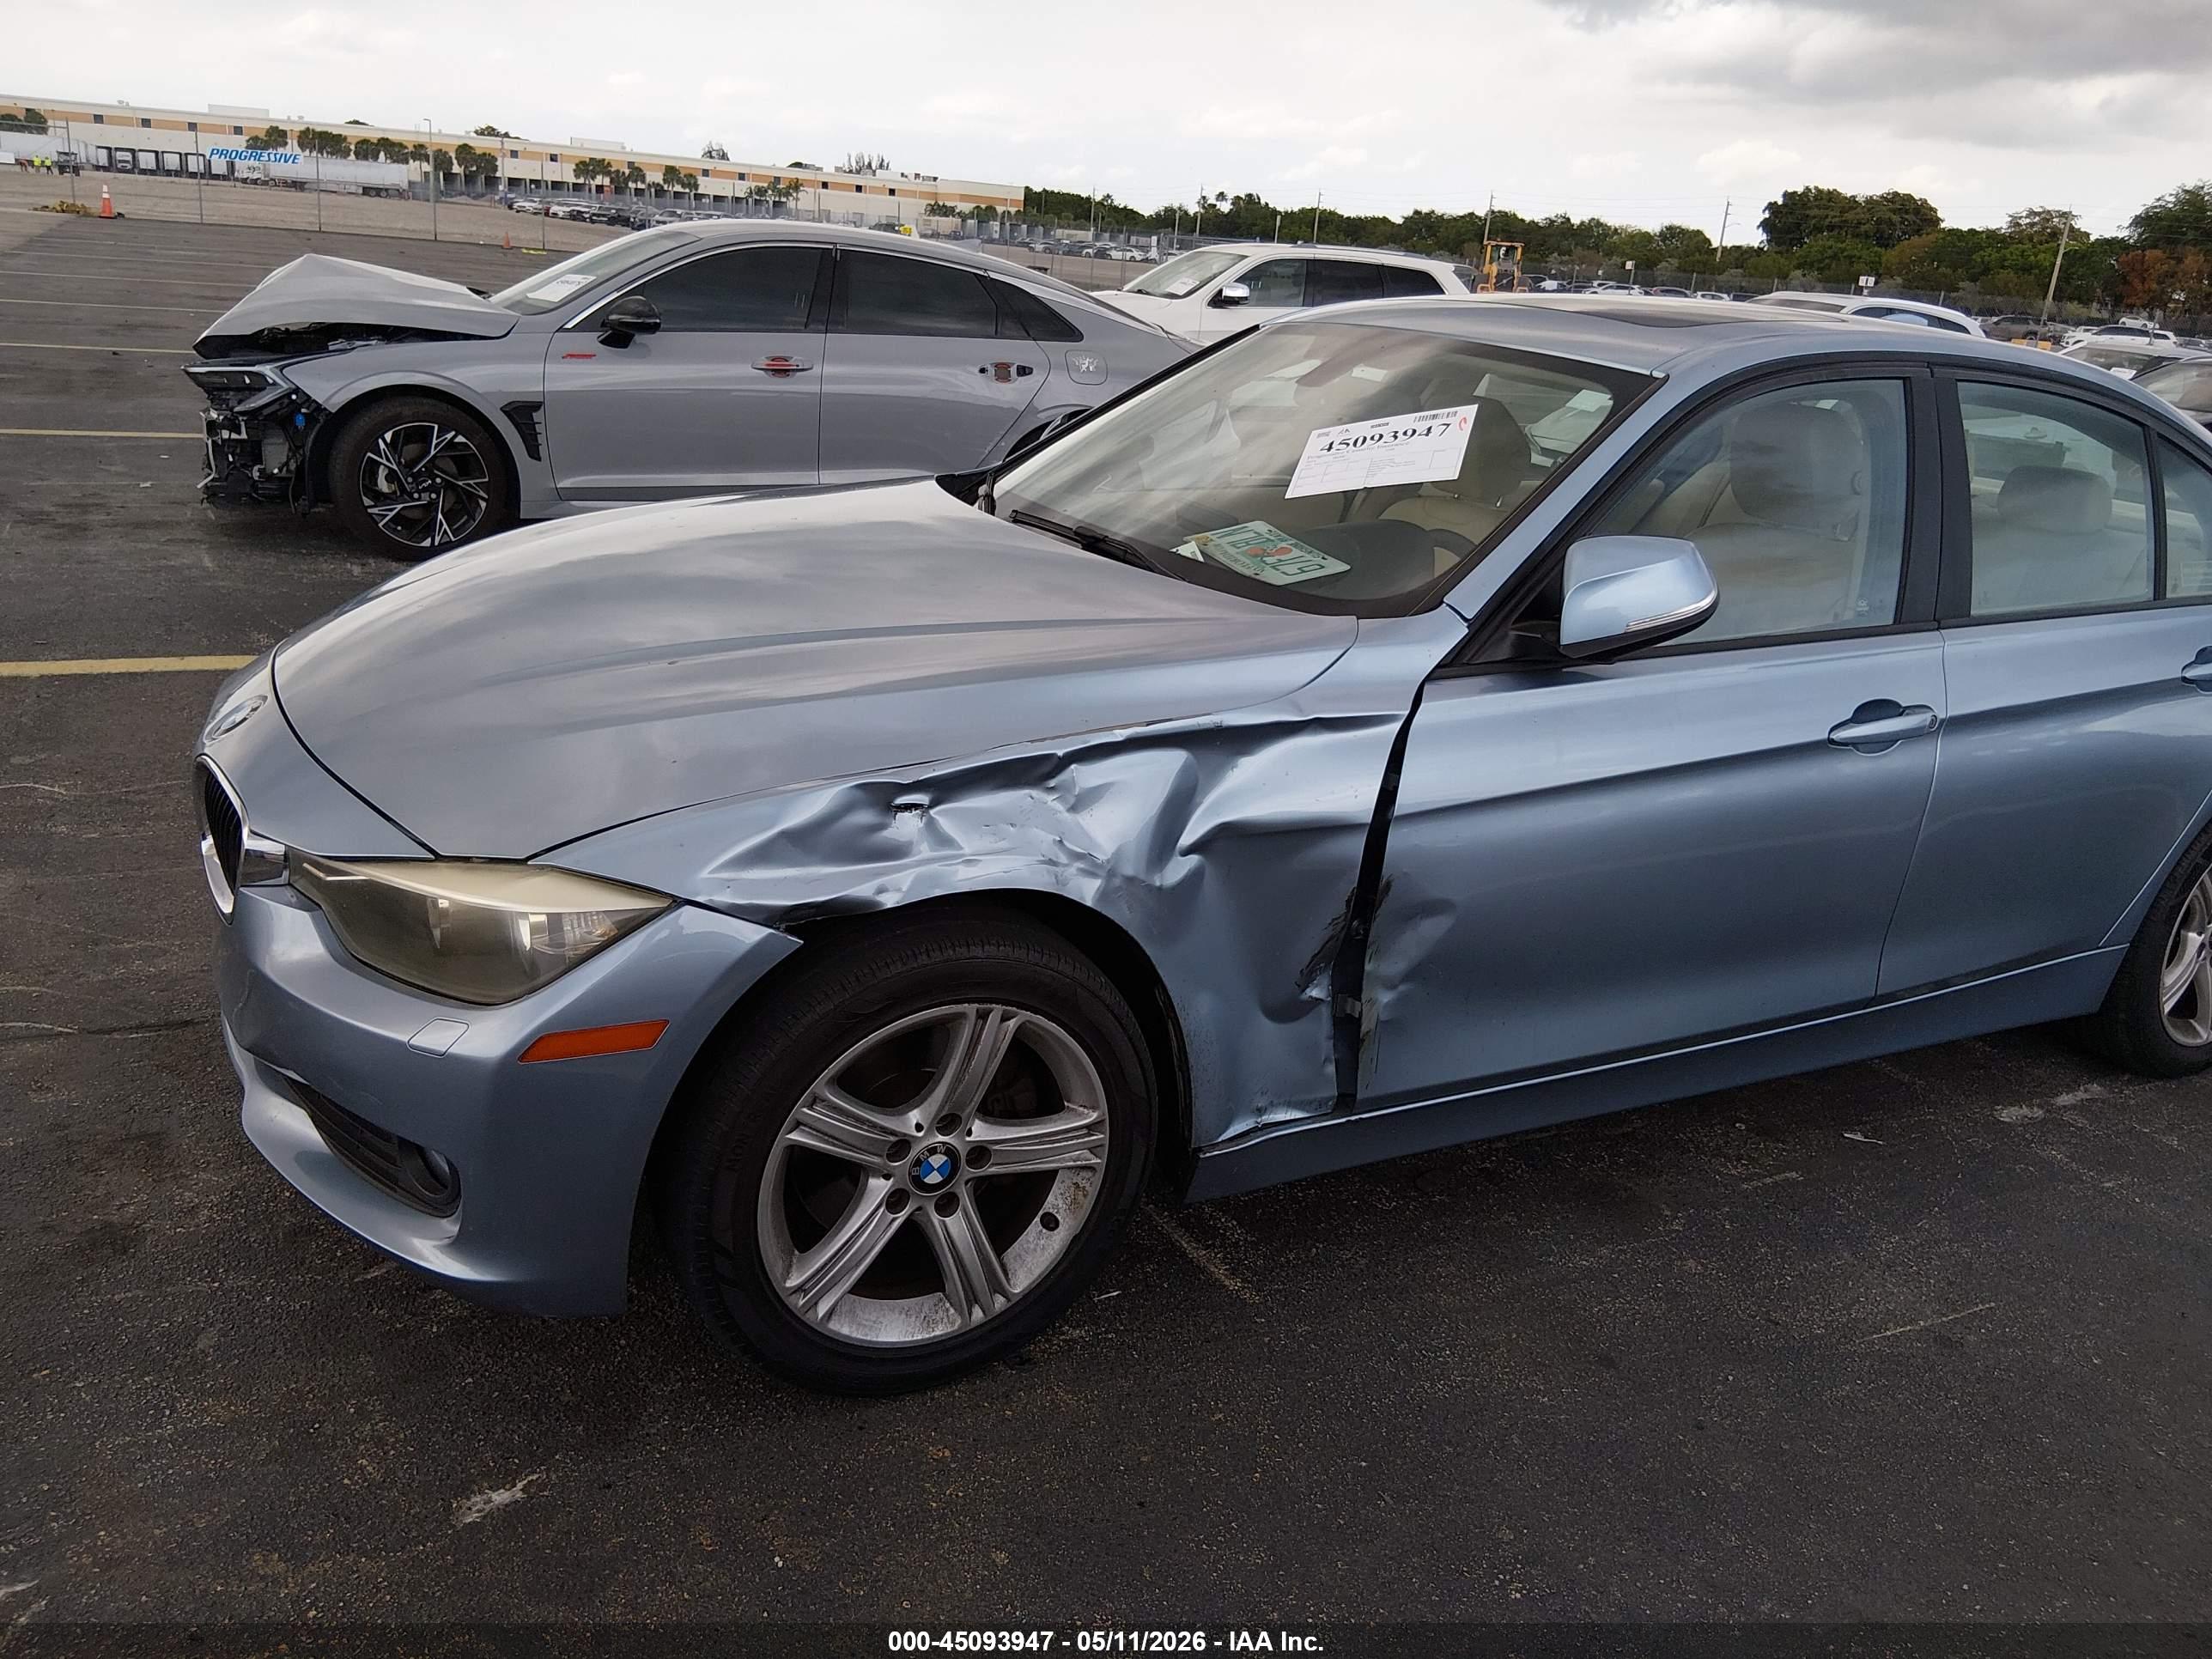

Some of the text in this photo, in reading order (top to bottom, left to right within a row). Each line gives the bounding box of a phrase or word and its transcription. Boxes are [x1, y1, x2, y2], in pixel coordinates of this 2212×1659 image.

[209, 148, 301, 164] PROGRESSIVE
[1319, 422, 1451, 453] 45093947
[911, 1145, 947, 1176] BMW
